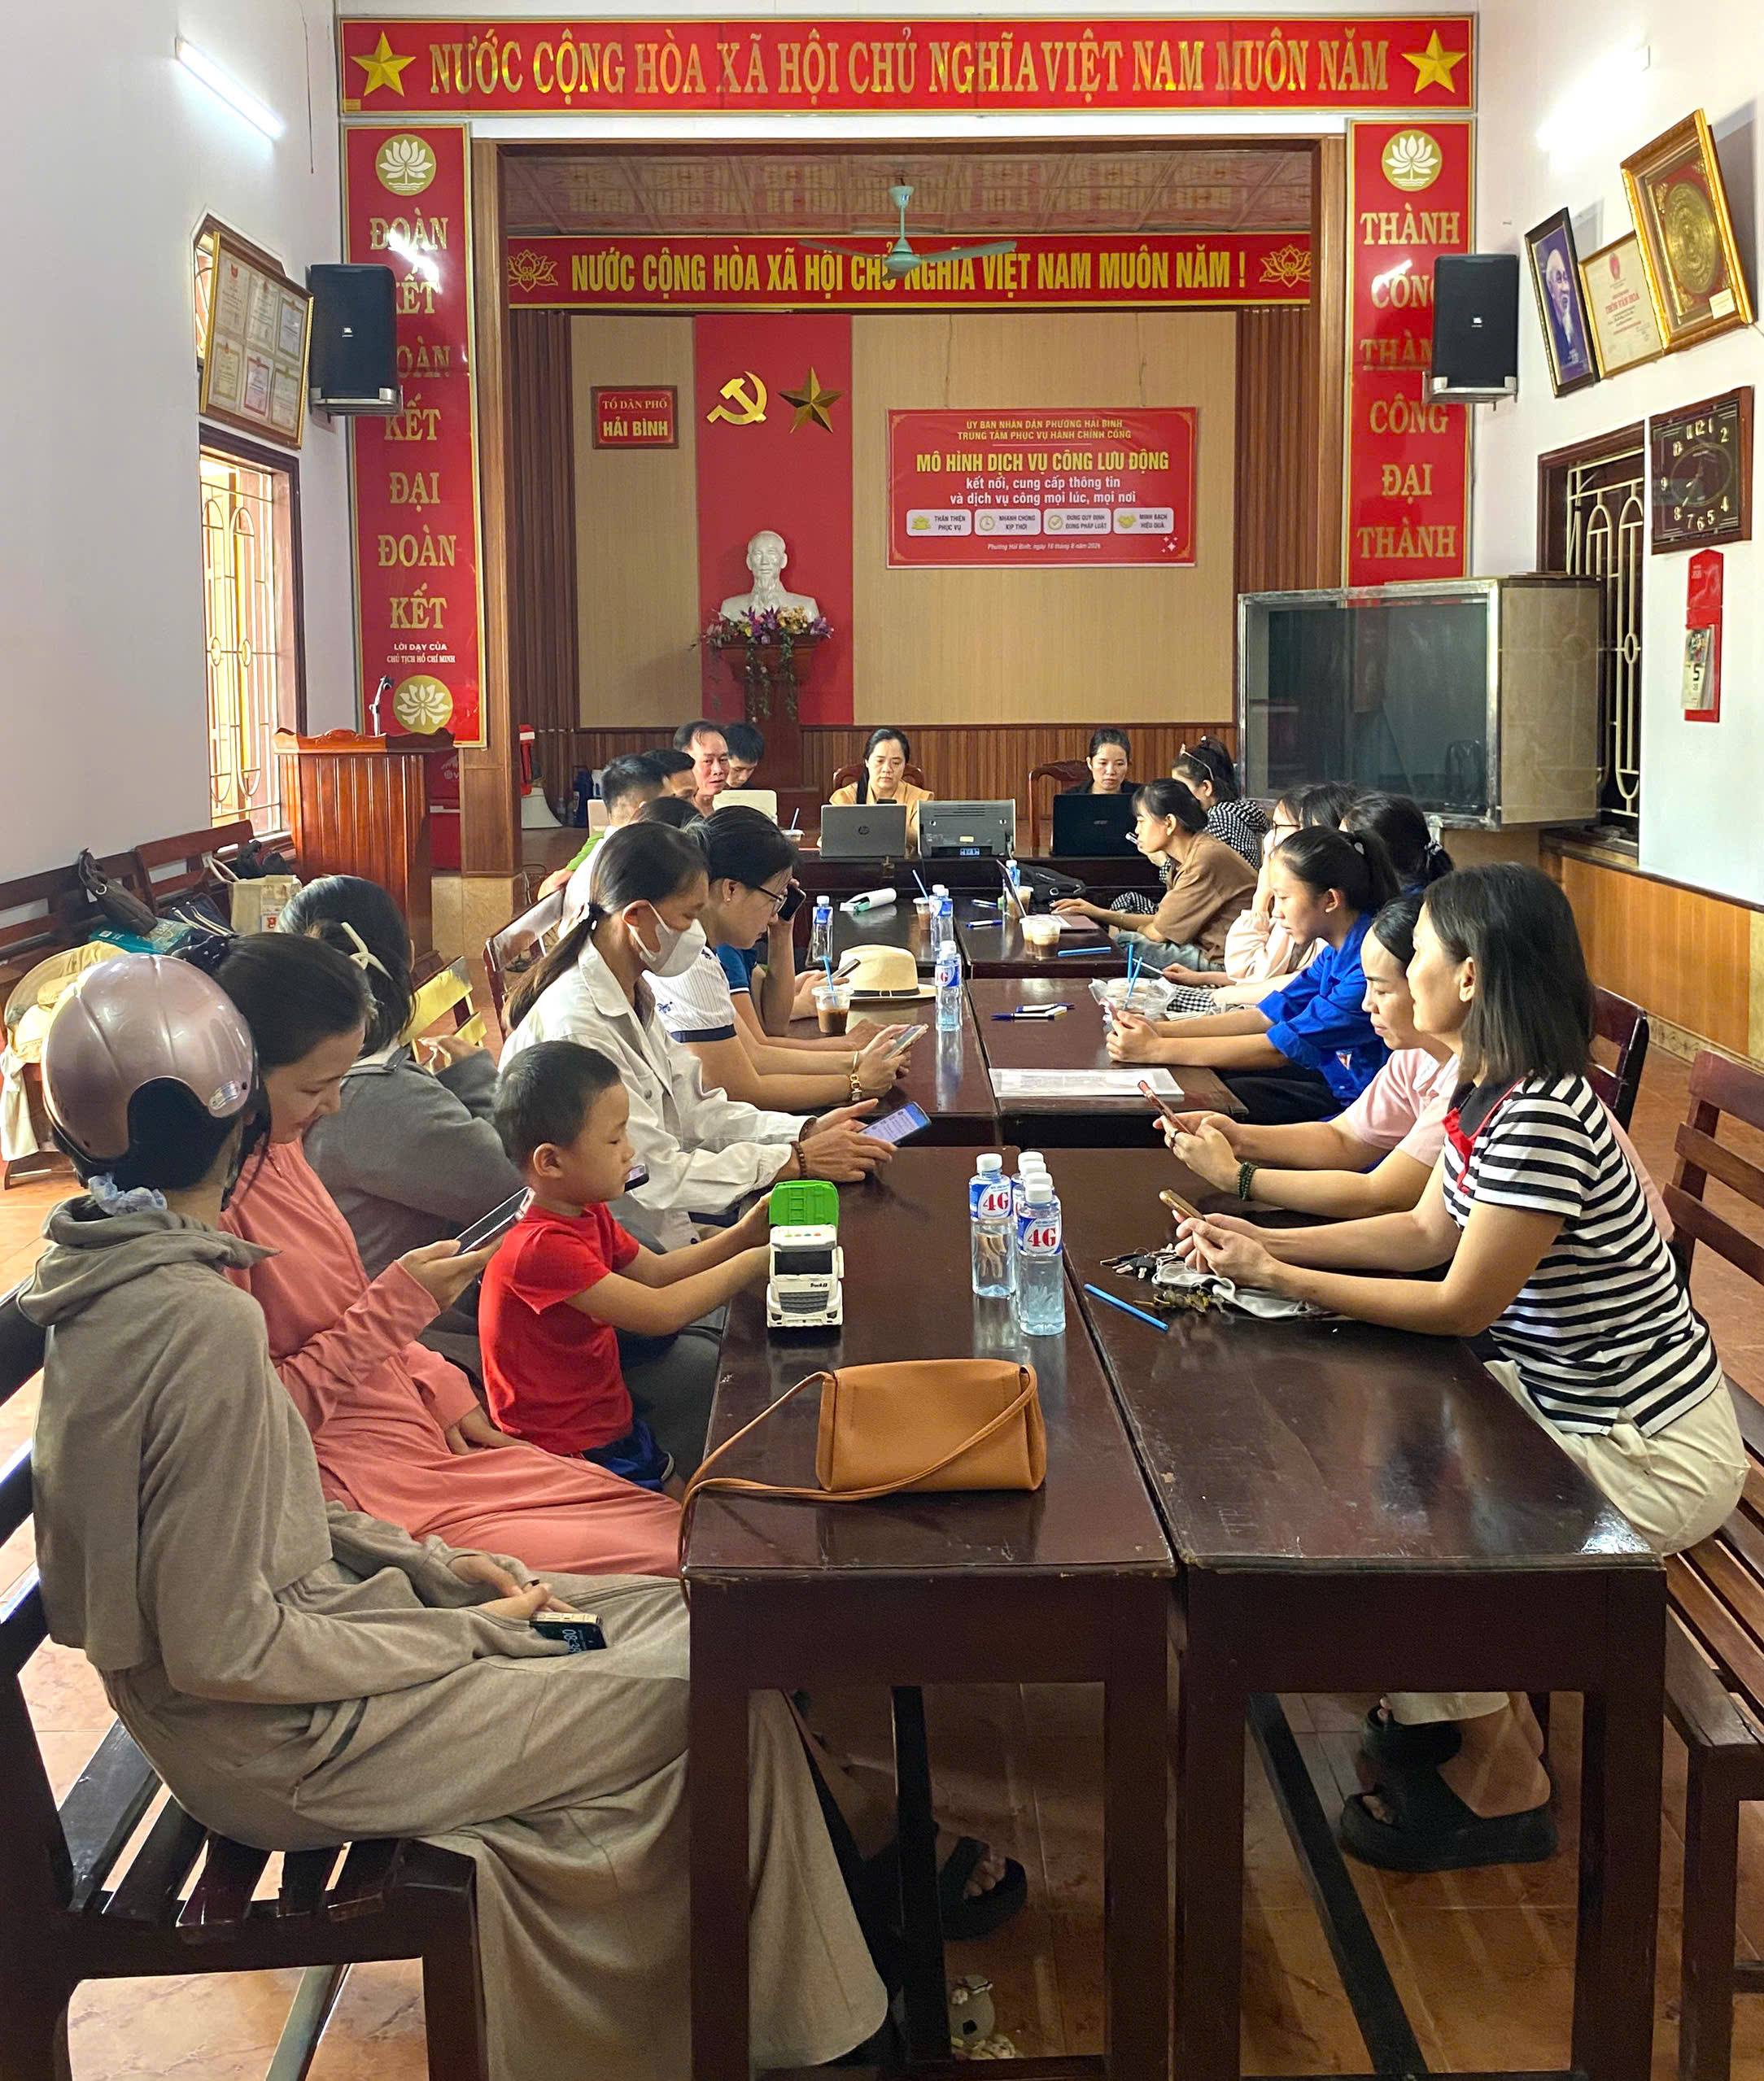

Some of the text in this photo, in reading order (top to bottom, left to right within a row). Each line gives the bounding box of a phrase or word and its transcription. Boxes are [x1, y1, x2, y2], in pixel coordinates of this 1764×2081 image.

[430, 26, 1389, 105] NƯỚC CỘNG HÒA XÃ HỘI CHỦ NGHĨA VIỆT NAM MUÔN NĂM
[369, 207, 448, 250] ĐOÀN
[1360, 203, 1460, 245] THÀNH
[571, 246, 635, 291] NƯỚC
[642, 246, 705, 299] CỘNG
[714, 245, 760, 291] HÒA
[766, 247, 797, 291] XÃ
[805, 249, 843, 299] HỘI
[982, 250, 1031, 298] VIỆT
[1037, 253, 1091, 290] NAM
[1099, 244, 1168, 290] MUÔN
[1176, 244, 1230, 289] NĂM
[397, 334, 450, 378] OÀN
[1360, 329, 1433, 371] THÀN
[384, 393, 441, 440] KẾT
[620, 399, 642, 409] DÂN
[644, 397, 667, 409] PHỐ
[1369, 393, 1448, 434] CÔNG
[604, 417, 668, 437] HẢI BÌNH
[957, 431, 987, 440] TRUNG
[980, 421, 997, 430] BAN
[916, 448, 1169, 476] MÔ HÌNH DỊCH VỤ CÔNG LƯU ĐỘNG
[966, 475, 985, 489] kết
[1013, 478, 1041, 491] cung
[1045, 474, 1065, 491] cấp
[1069, 476, 1102, 491] thông
[1105, 476, 1120, 488] tin
[390, 472, 440, 513] ĐẠI
[950, 493, 963, 504] và
[967, 492, 991, 507] dịch
[995, 494, 1009, 507] vụ
[1013, 491, 1041, 506] công
[1045, 491, 1065, 506] mọi
[1094, 491, 1115, 506] mọi
[1118, 491, 1136, 504] nơi
[1382, 464, 1433, 504] ĐẠI
[378, 525, 456, 567] ĐOÀN
[1356, 517, 1456, 559] THÀNH
[390, 582, 448, 630] KẾT
[409, 643, 427, 652] DẠY
[429, 640, 448, 651] CỦA
[983, 1192, 1009, 1211] 4G
[1028, 1228, 1056, 1247] 4G
